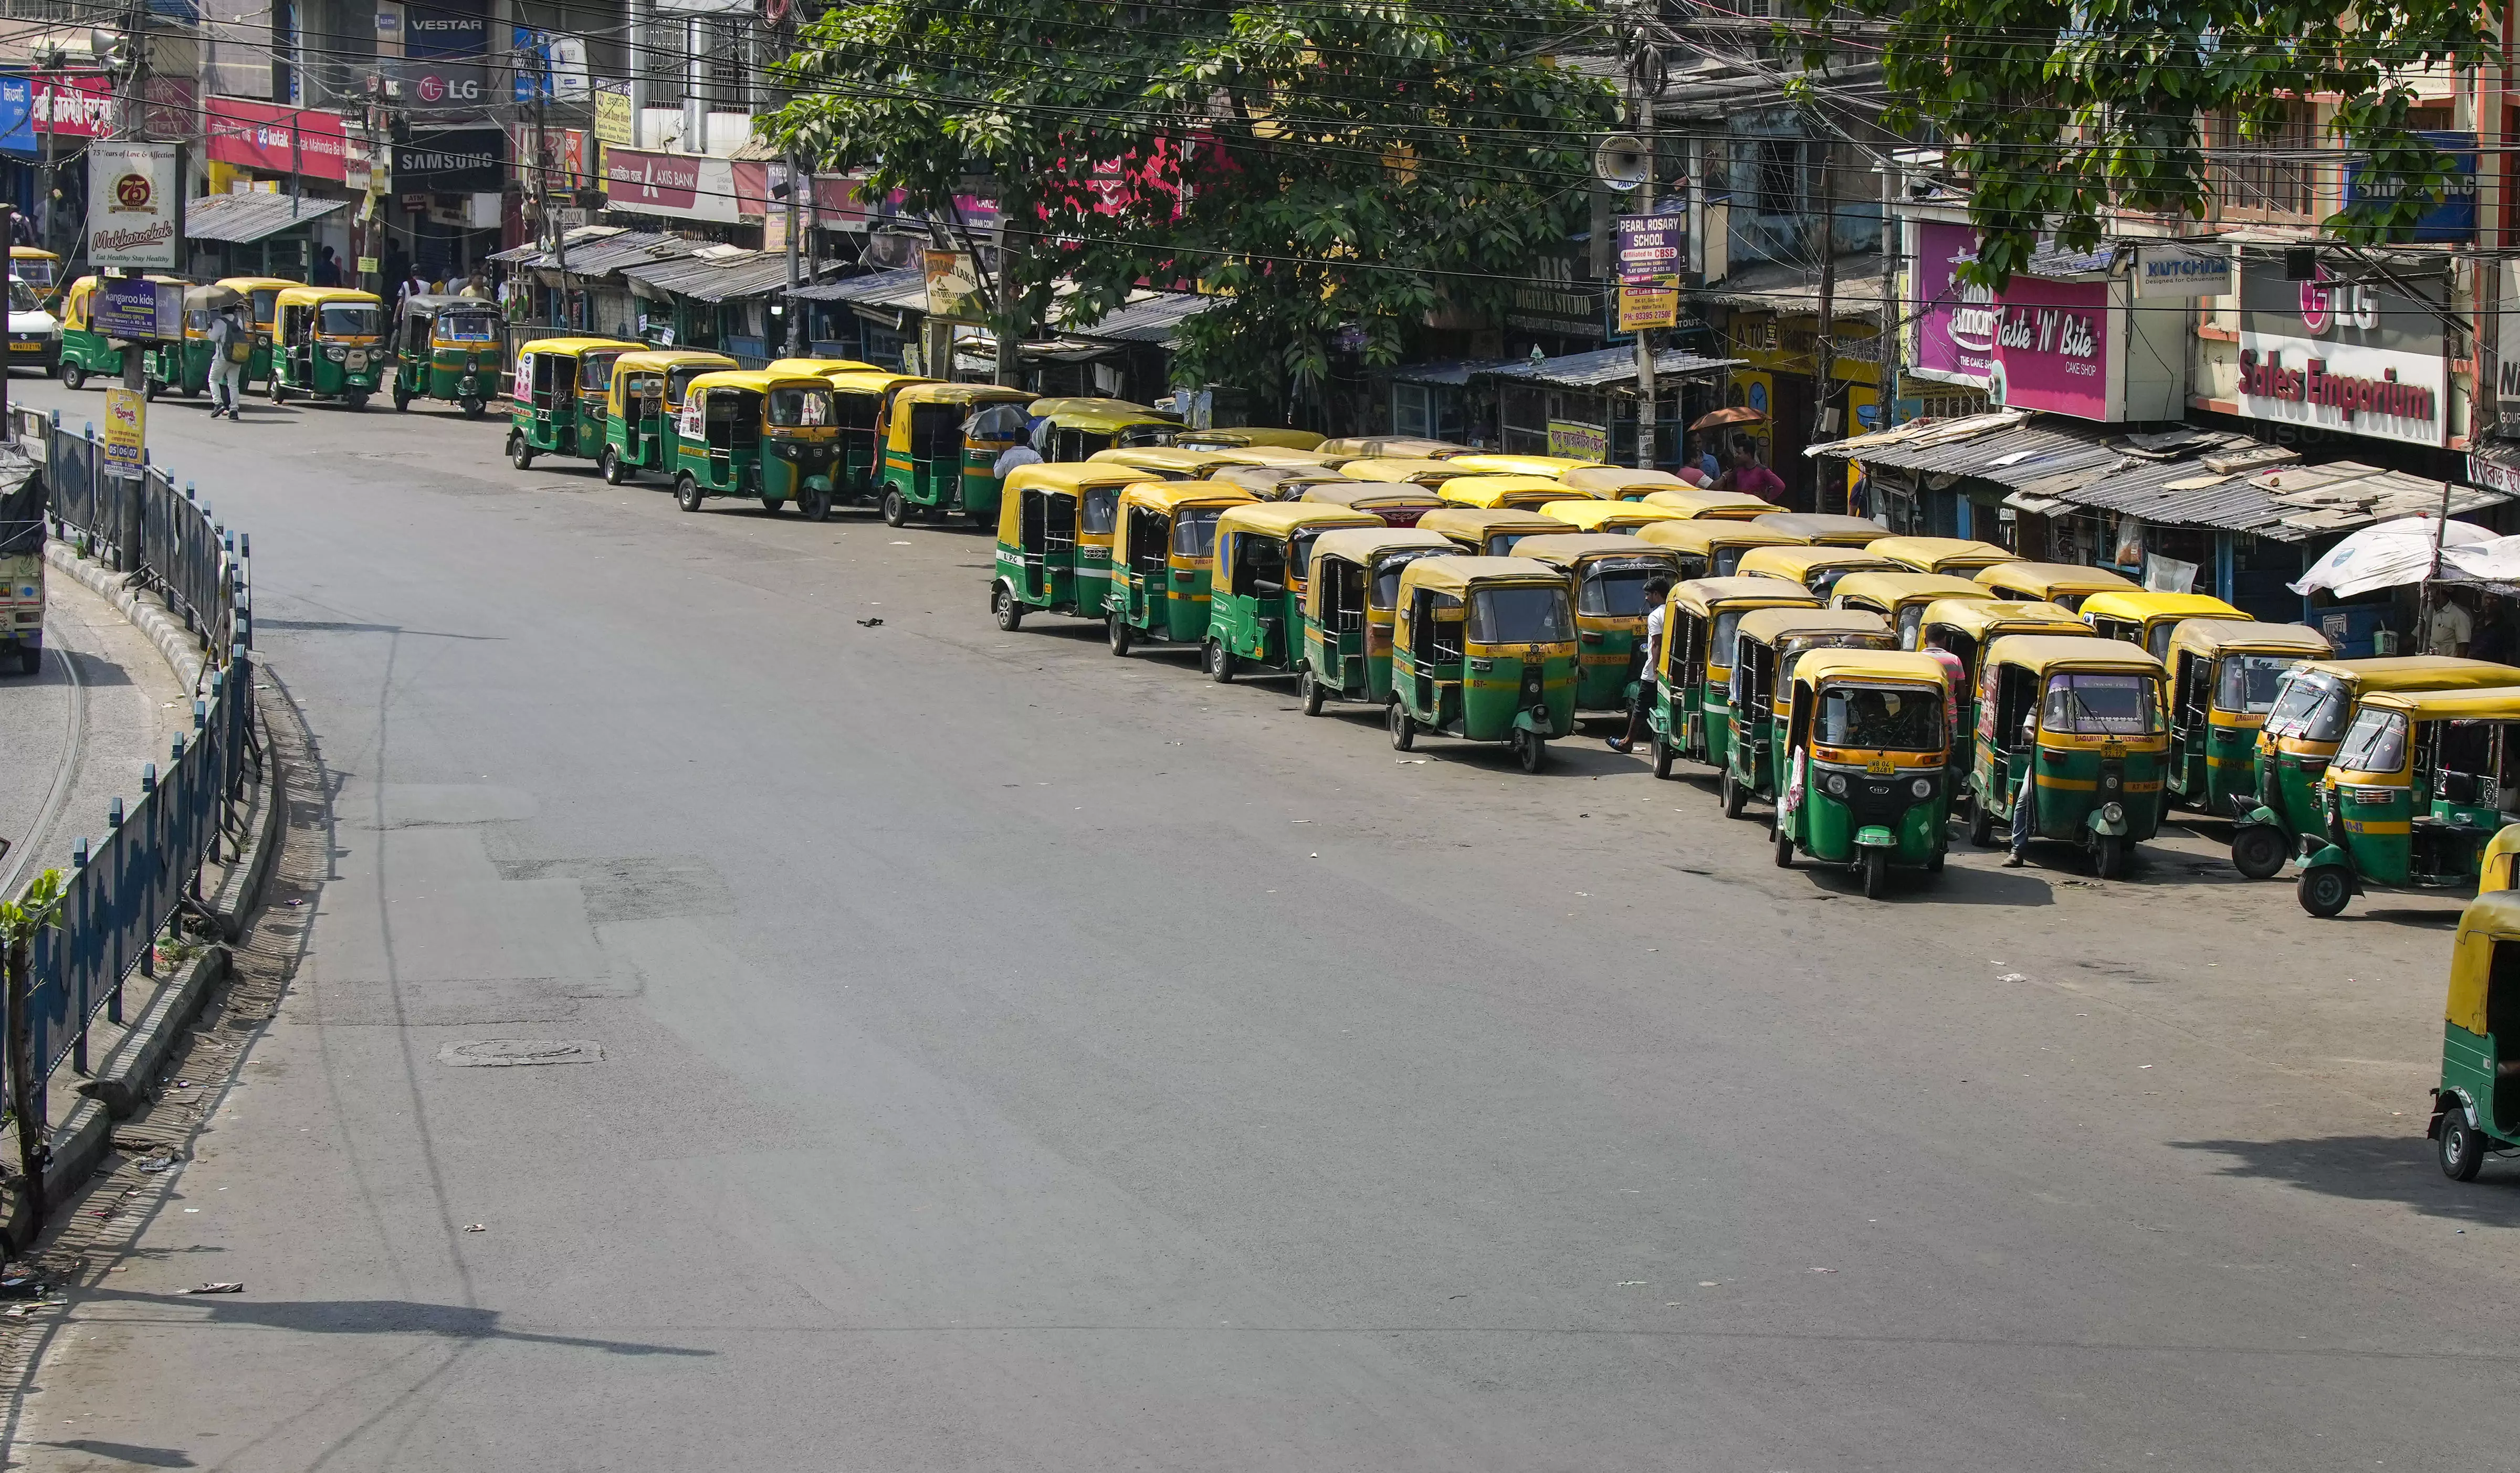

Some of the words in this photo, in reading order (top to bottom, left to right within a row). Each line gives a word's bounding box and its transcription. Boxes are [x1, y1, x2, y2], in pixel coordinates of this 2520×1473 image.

[412, 19, 482, 30] VESTAR
[449, 79, 478, 99] LG
[269, 129, 289, 148] kotak
[310, 139, 333, 154] Mahindra
[119, 150, 125, 159] of
[150, 151, 175, 160] Affection
[402, 152, 492, 170] SAMSUNG
[657, 169, 673, 185] AXIS
[675, 171, 695, 187] BANK
[2356, 175, 2475, 197] SAMNG
[121, 180, 146, 201] 75
[1620, 220, 1645, 233] PEARL
[1647, 218, 1678, 231] ROSARY
[92, 220, 173, 252] Mukharochak
[1633, 234, 1664, 247] SCHOOL
[107, 254, 131, 262] Healthy
[1655, 248, 1674, 258] CBSE
[106, 290, 138, 305] kangaroo
[139, 293, 154, 306] kids
[1516, 289, 1554, 311] DIGITAL
[1556, 293, 1591, 315] STUDIO
[2335, 272, 2379, 330] LG
[1624, 312, 1634, 321] PH:
[1635, 312, 1653, 320] 93395
[1654, 311, 1671, 319] 27506
[1736, 323, 1748, 351] A
[1993, 306, 2031, 349] Taste
[2060, 314, 2092, 357] Bite
[1960, 355, 1969, 366] THE
[1970, 357, 1984, 368] CAKE
[2065, 361, 2080, 374] CAKE
[2081, 364, 2096, 376] SHOP
[2240, 349, 2305, 402] Sales
[2307, 359, 2434, 422] Emporium
[119, 447, 128, 456] 06
[129, 449, 137, 458] 07
[1003, 553, 1017, 563] L.P.G
